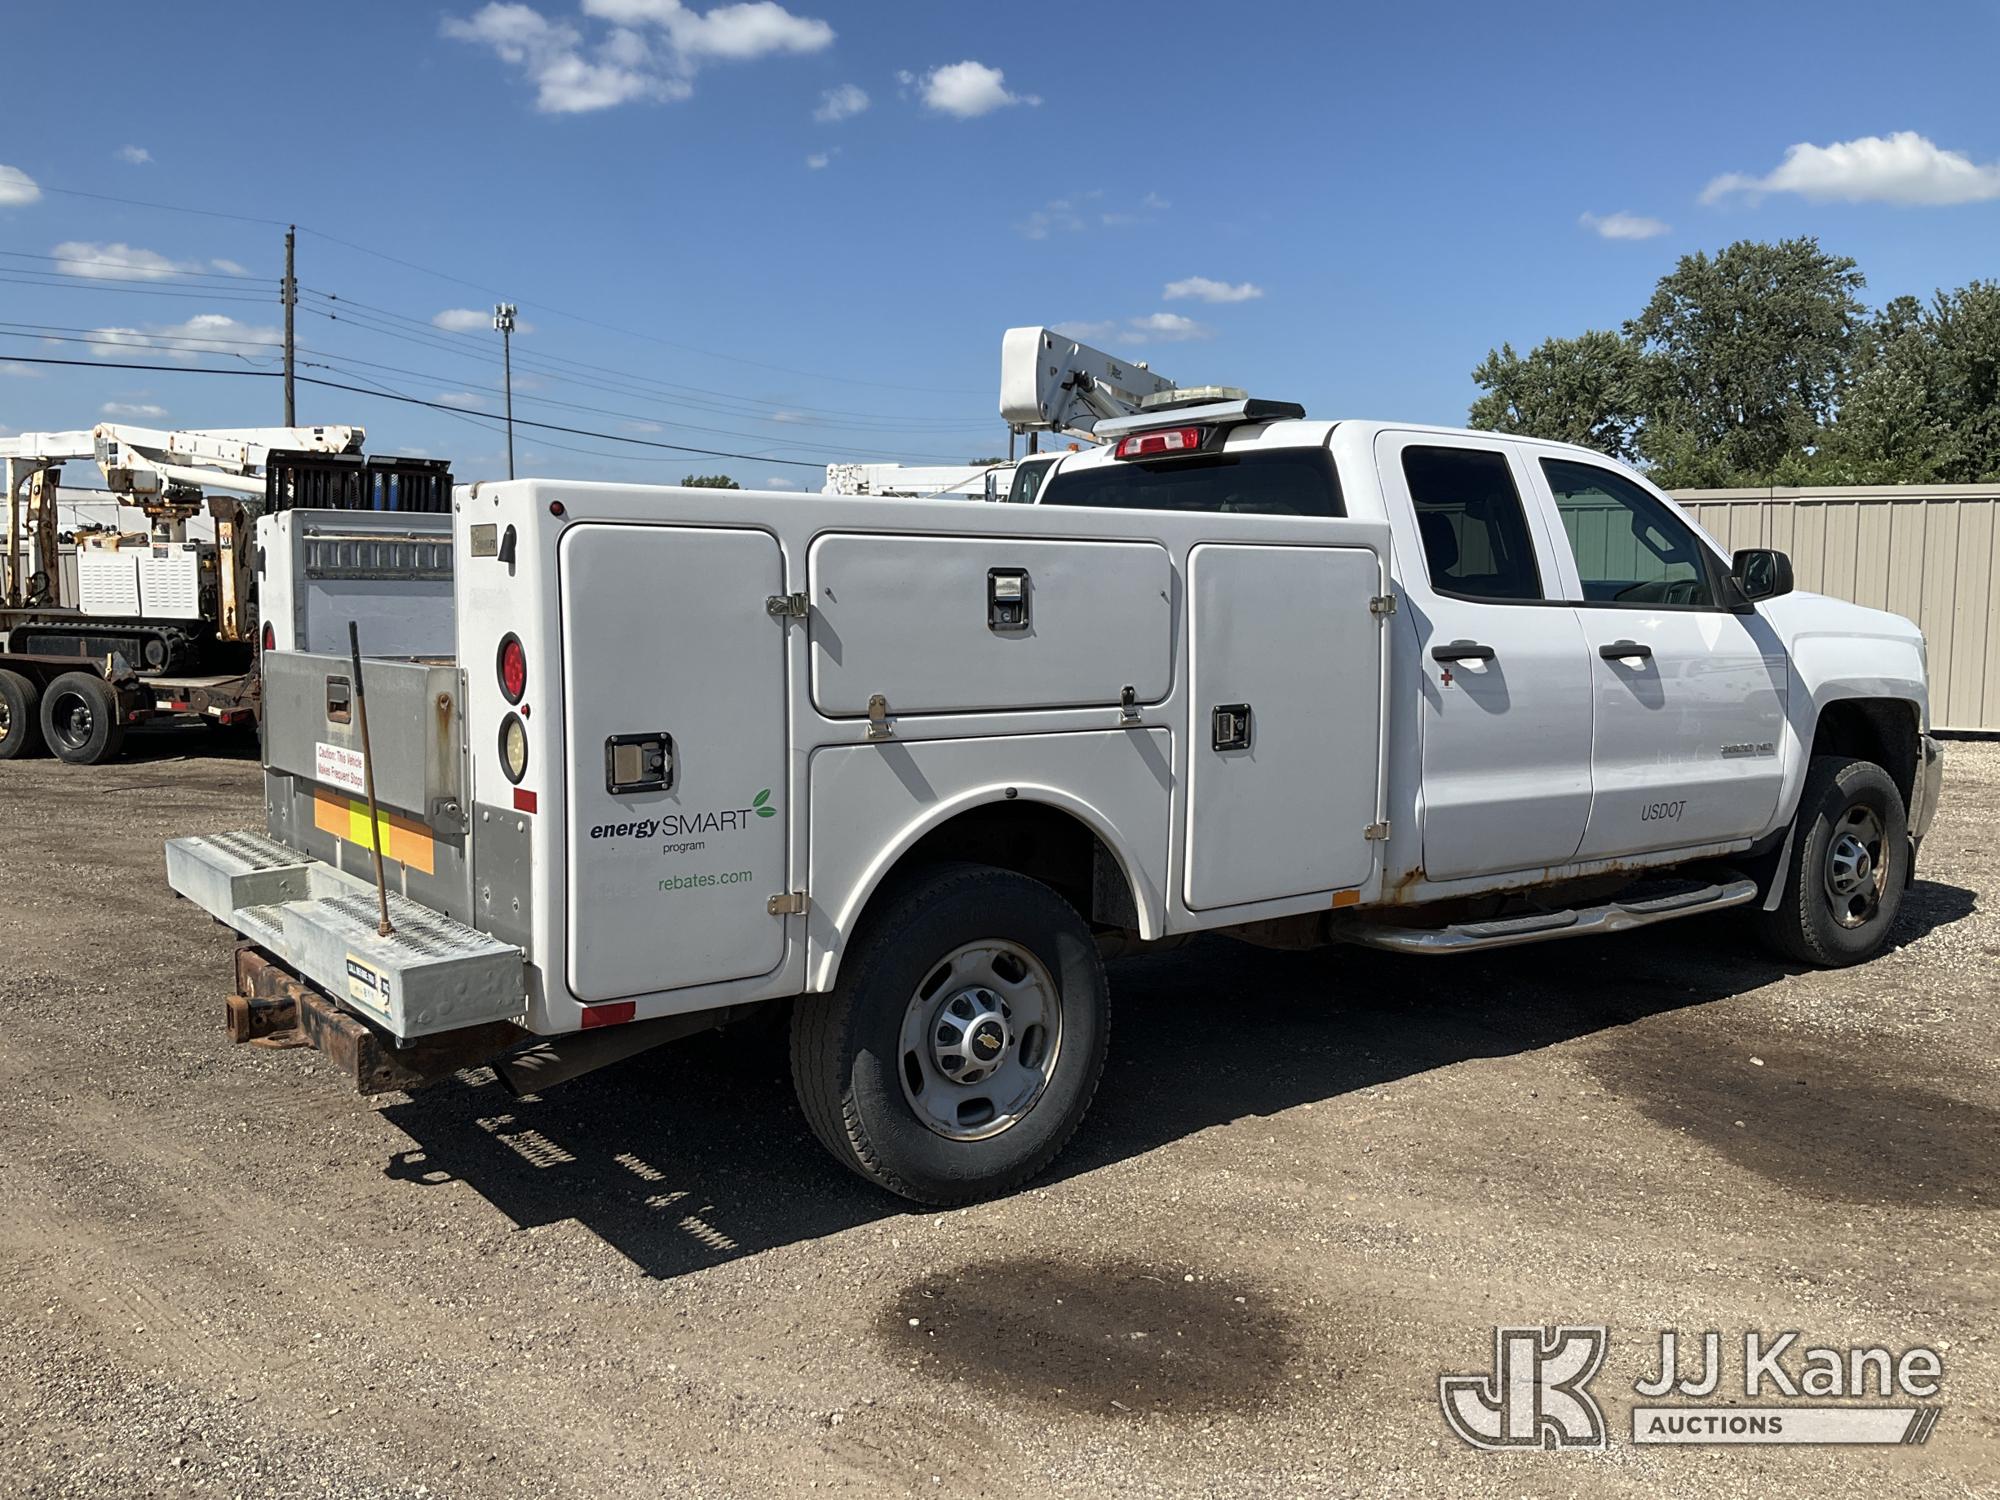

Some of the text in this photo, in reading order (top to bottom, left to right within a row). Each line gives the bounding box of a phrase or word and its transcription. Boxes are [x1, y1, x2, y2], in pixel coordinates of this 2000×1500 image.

[1641, 801, 1687, 822] USDOT
[663, 840, 705, 855] program
[658, 869, 752, 891] rebates.com
